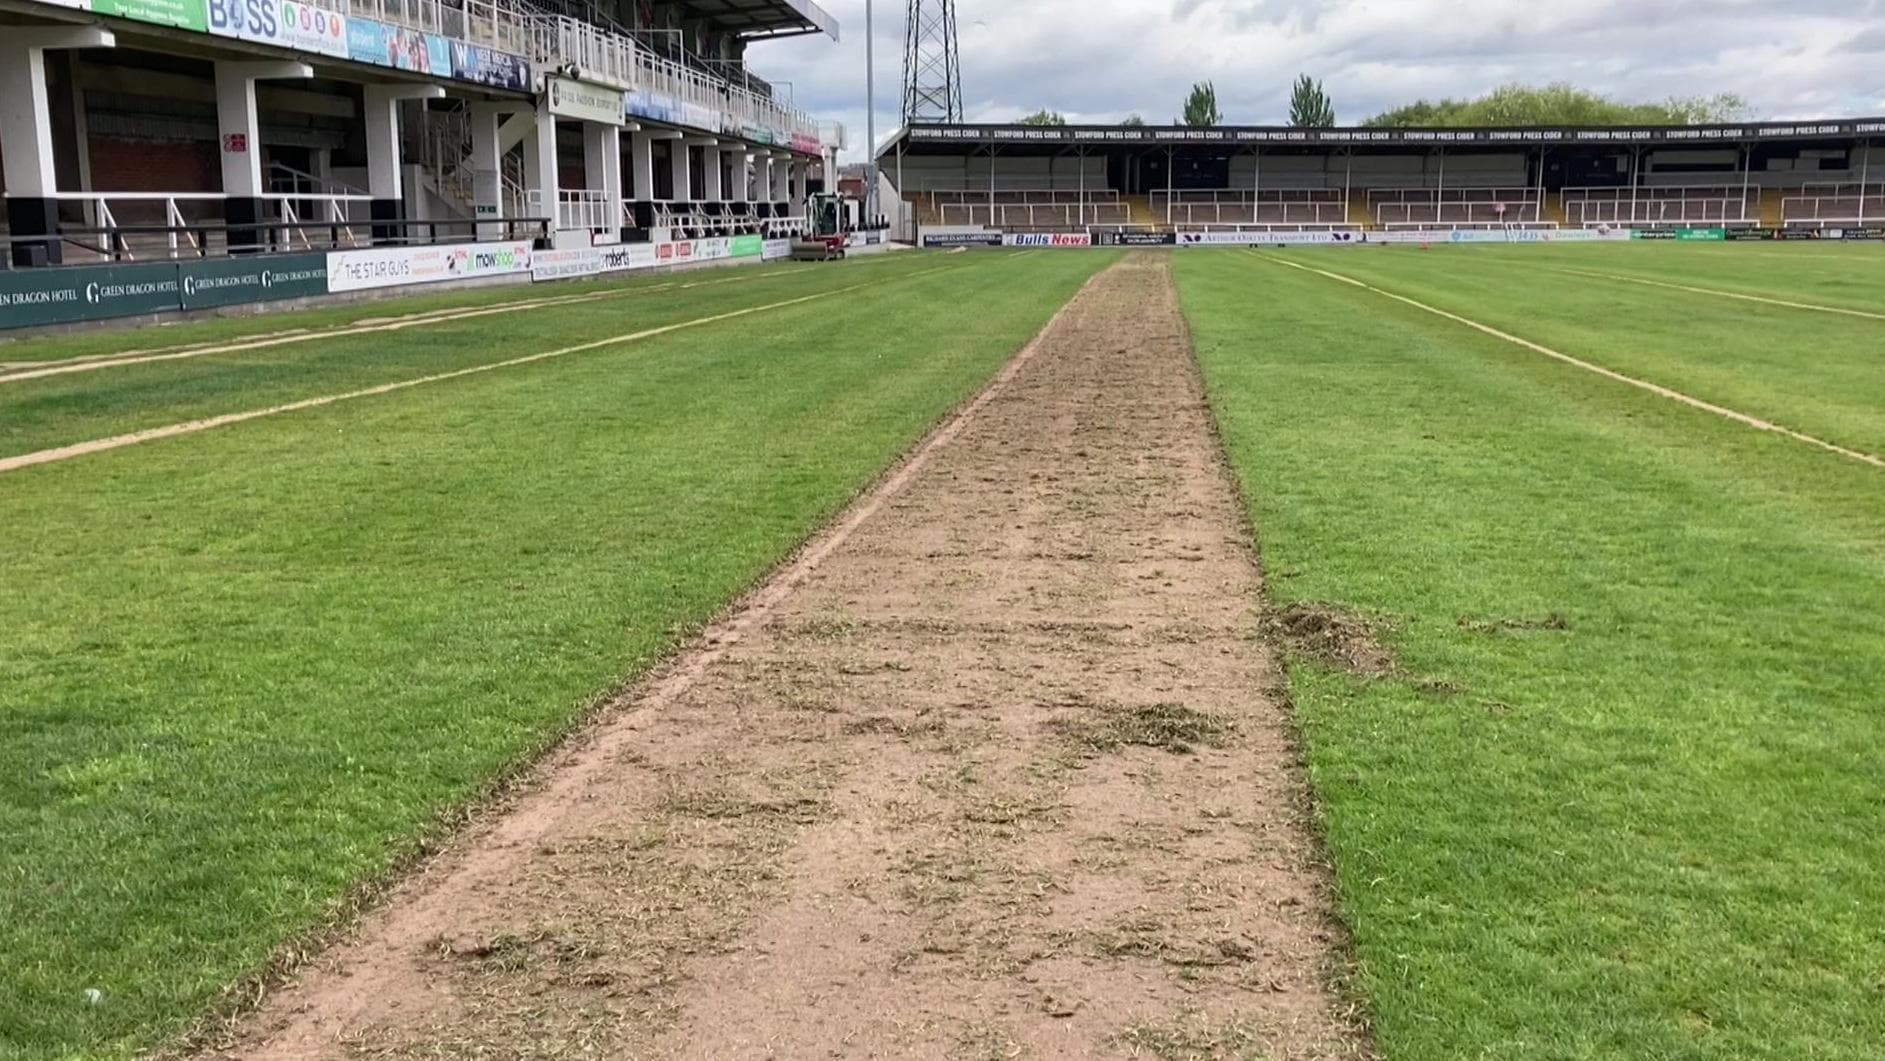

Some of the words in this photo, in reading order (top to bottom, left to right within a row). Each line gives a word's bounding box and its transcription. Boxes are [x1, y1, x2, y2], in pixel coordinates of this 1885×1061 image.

[943, 129, 961, 137] PRESS
[962, 129, 980, 137] CIDER
[1701, 129, 1721, 137] PRESS
[1722, 129, 1742, 137] CIDER
[1795, 126, 1817, 134] PRESS
[1818, 125, 1839, 133] CIDER
[1025, 130, 1043, 138] PRESS
[1044, 130, 1061, 138] CIDER
[1106, 131, 1123, 139] PRESS
[1125, 131, 1142, 139] CIDER
[1187, 131, 1204, 139] PRESS
[1206, 131, 1223, 139] CIDER
[1269, 131, 1287, 139] PRESS
[1288, 131, 1306, 139] CIDER
[1523, 131, 1542, 139] PRESS
[1543, 131, 1562, 139] CIDER
[1611, 131, 1630, 139] PRESS
[1631, 131, 1651, 139] CIDER
[1016, 234, 1049, 245] Bulls
[1051, 234, 1089, 246] News
[345, 263, 362, 279] THE
[389, 259, 409, 275] GUYS
[195, 279, 214, 290] GREEN
[215, 276, 240, 288] DRAGON
[241, 274, 259, 285] HOTEL
[100, 286, 125, 298] GREEN
[125, 282, 156, 295] DRAGON
[157, 280, 179, 292] HOTEL
[13, 292, 51, 304] DRAGON
[52, 289, 78, 302] HOTEL
